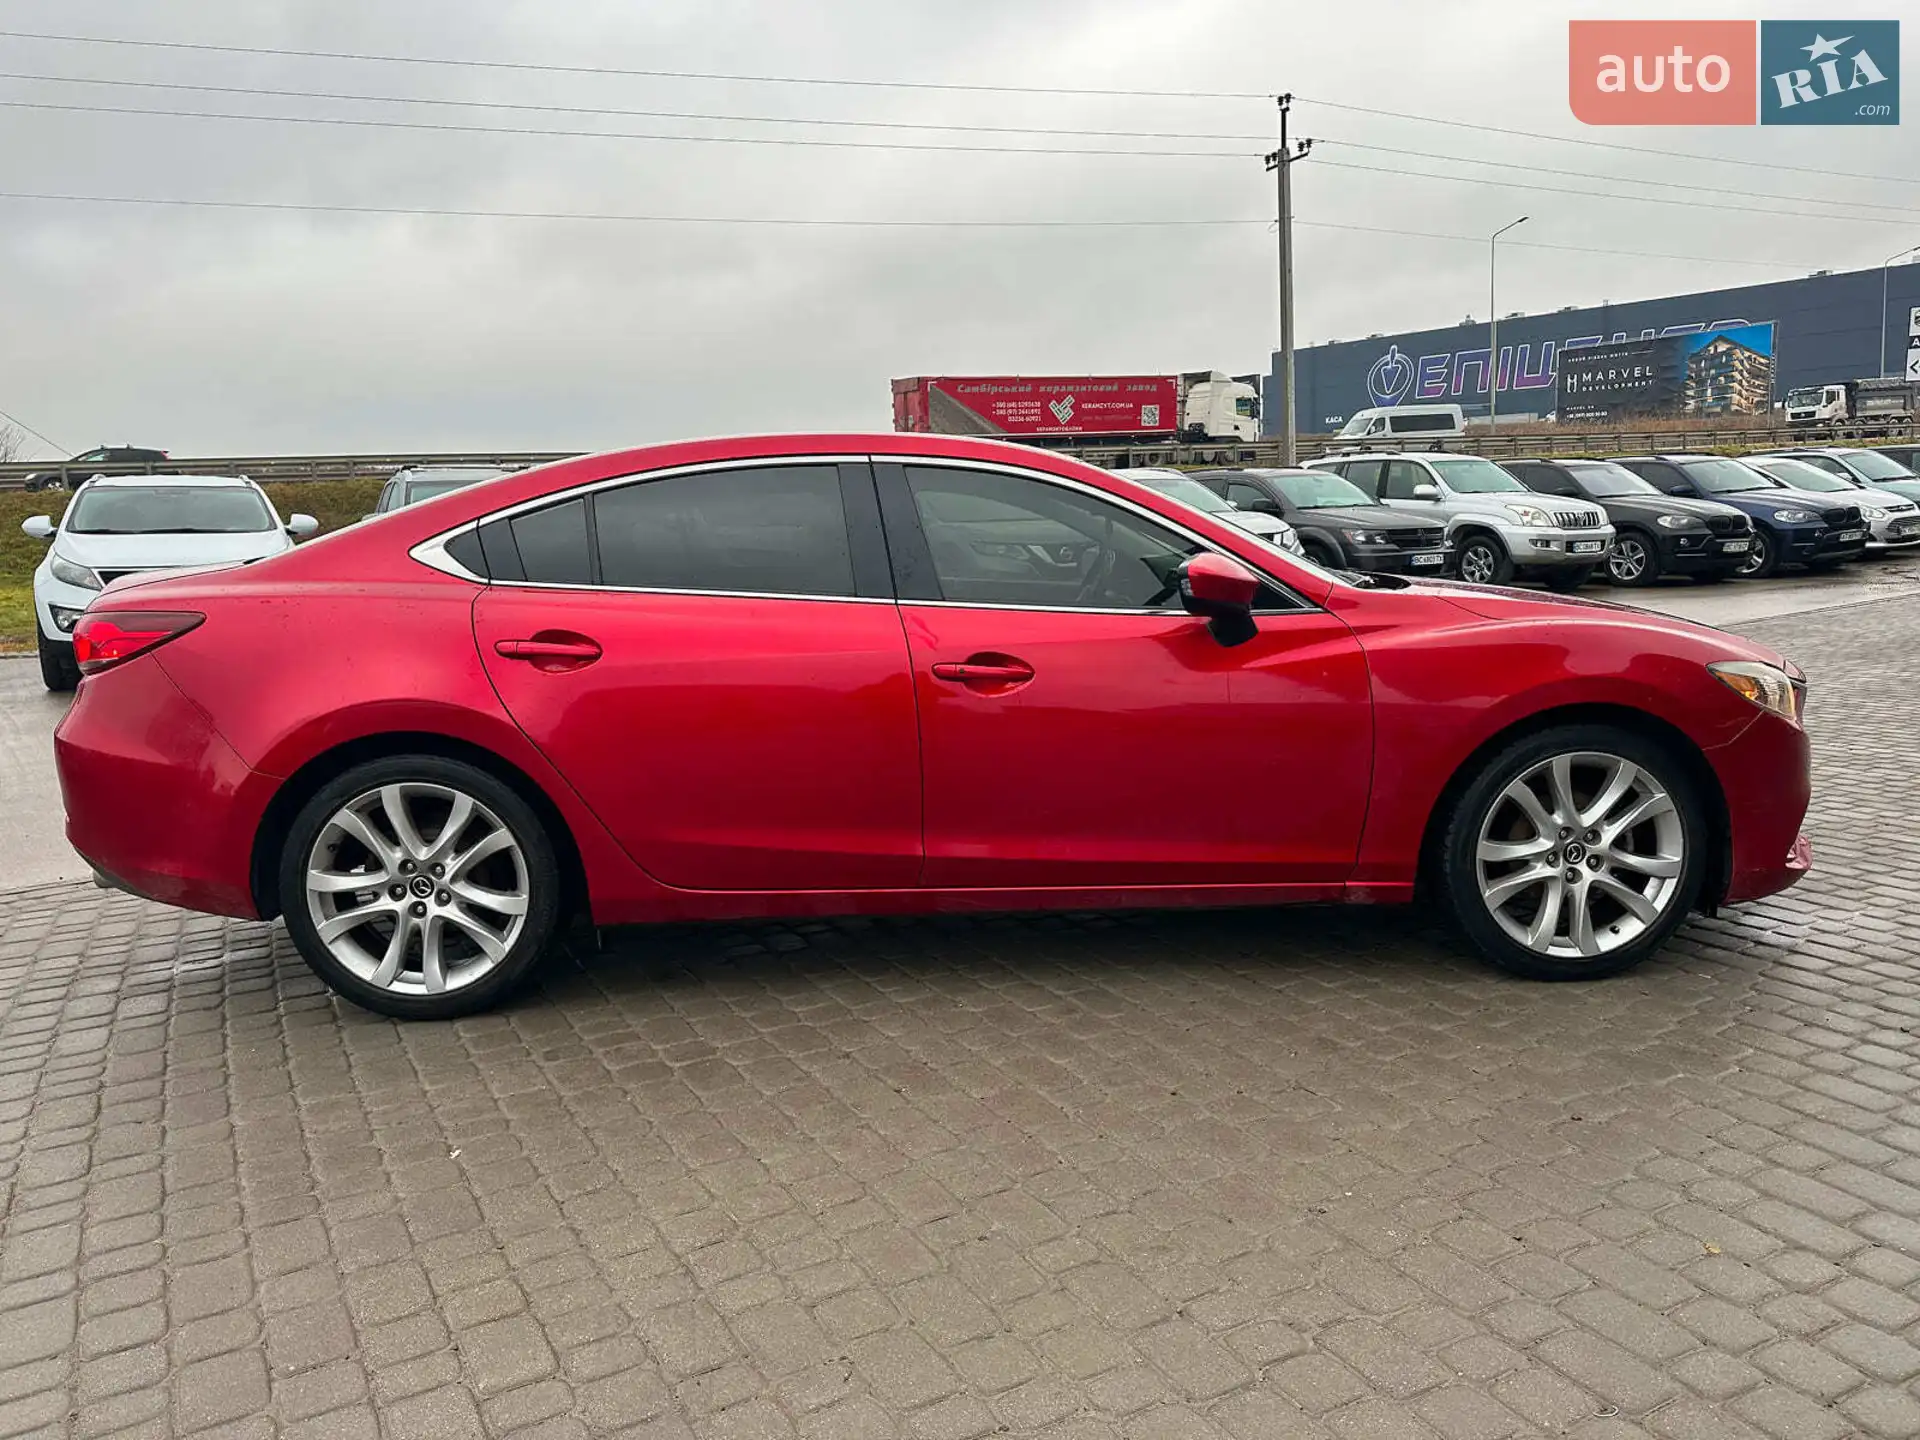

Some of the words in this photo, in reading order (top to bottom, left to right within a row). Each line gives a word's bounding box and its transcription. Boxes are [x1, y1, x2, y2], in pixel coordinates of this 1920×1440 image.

[1582, 366, 1653, 382] MARVEL
[1126, 384, 1157, 392] завод
[1582, 379, 1653, 392] DEVELOPMENT
[1325, 416, 1344, 424] КАСА
